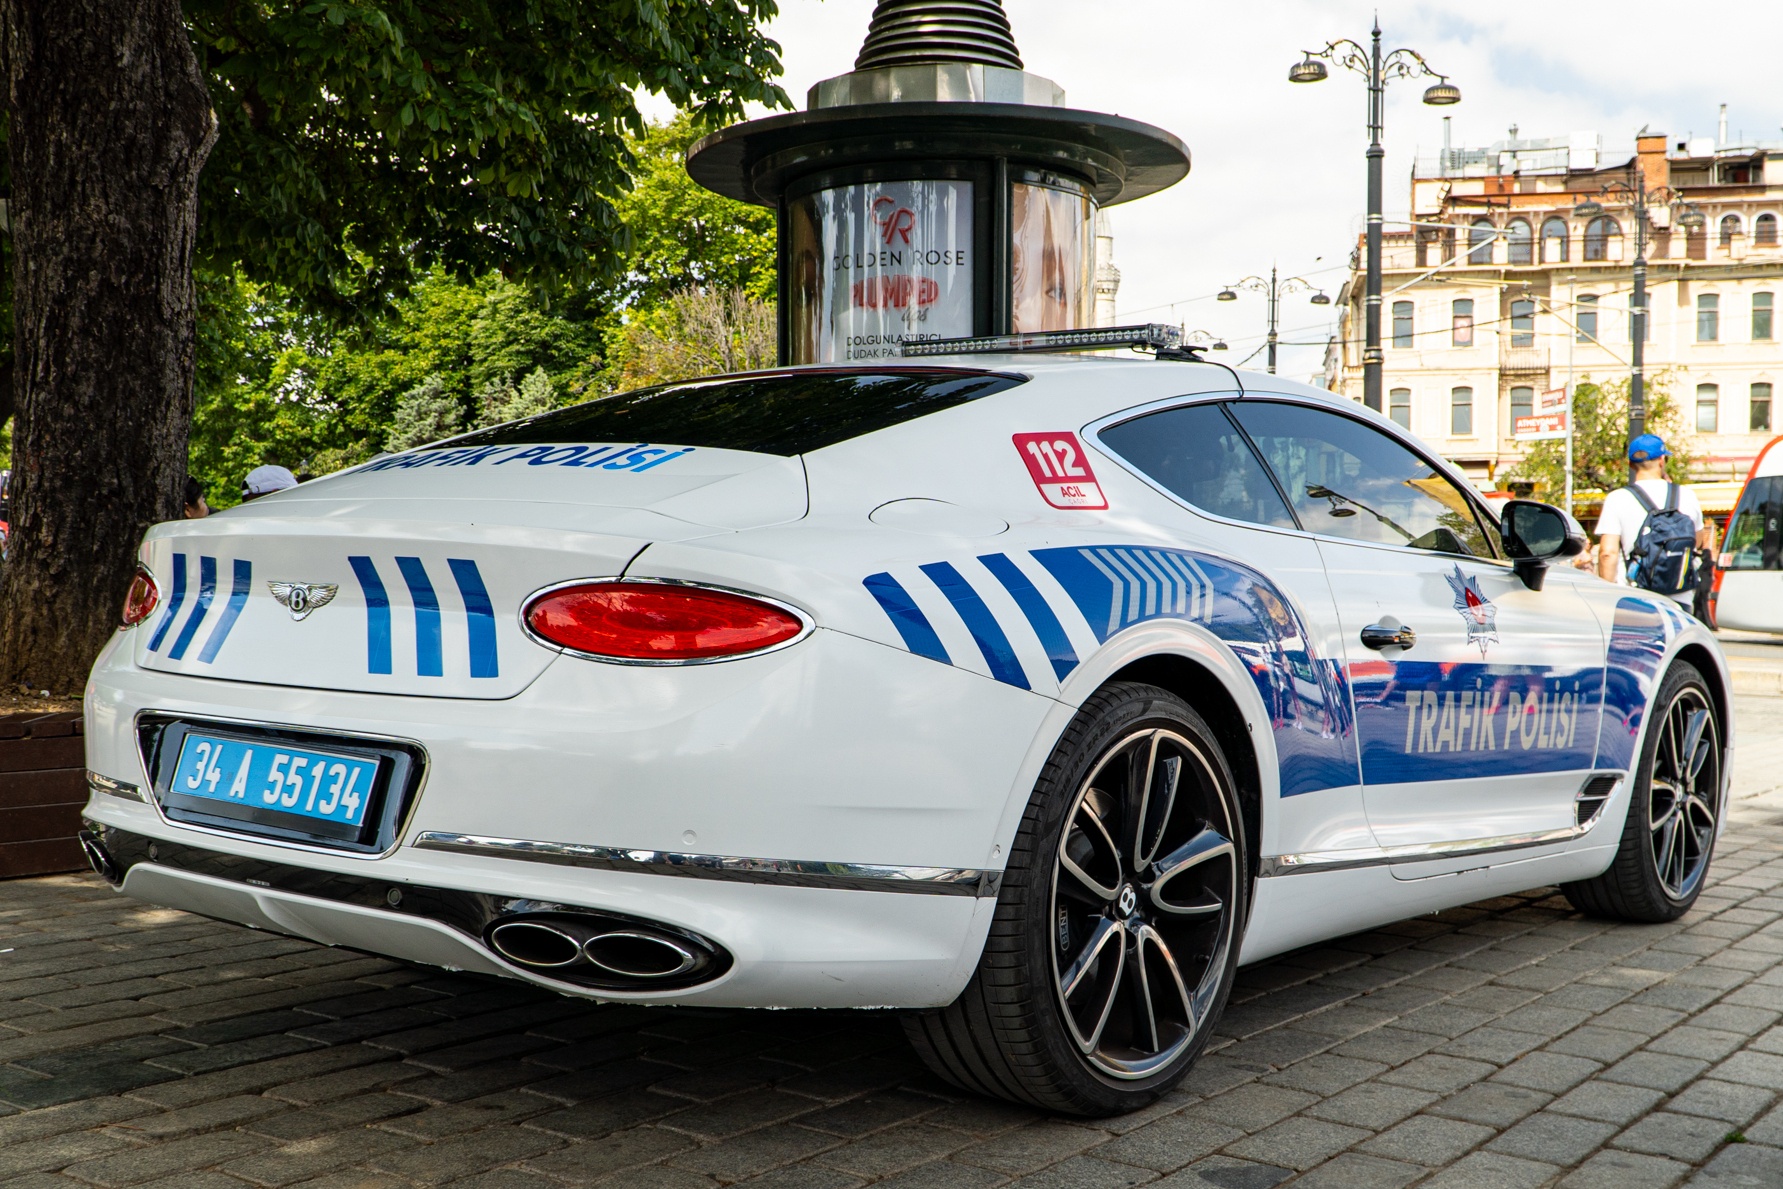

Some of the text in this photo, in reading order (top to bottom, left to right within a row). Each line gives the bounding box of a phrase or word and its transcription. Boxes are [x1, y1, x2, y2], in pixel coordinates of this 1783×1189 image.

[833, 249, 965, 271] GOLDEN ROSE
[846, 348, 880, 360] DUDAK
[1026, 439, 1087, 478] 112
[1404, 677, 1501, 754] TRAFİK
[1503, 680, 1580, 751] POLİSİ
[187, 741, 362, 820] 34 A 55134
